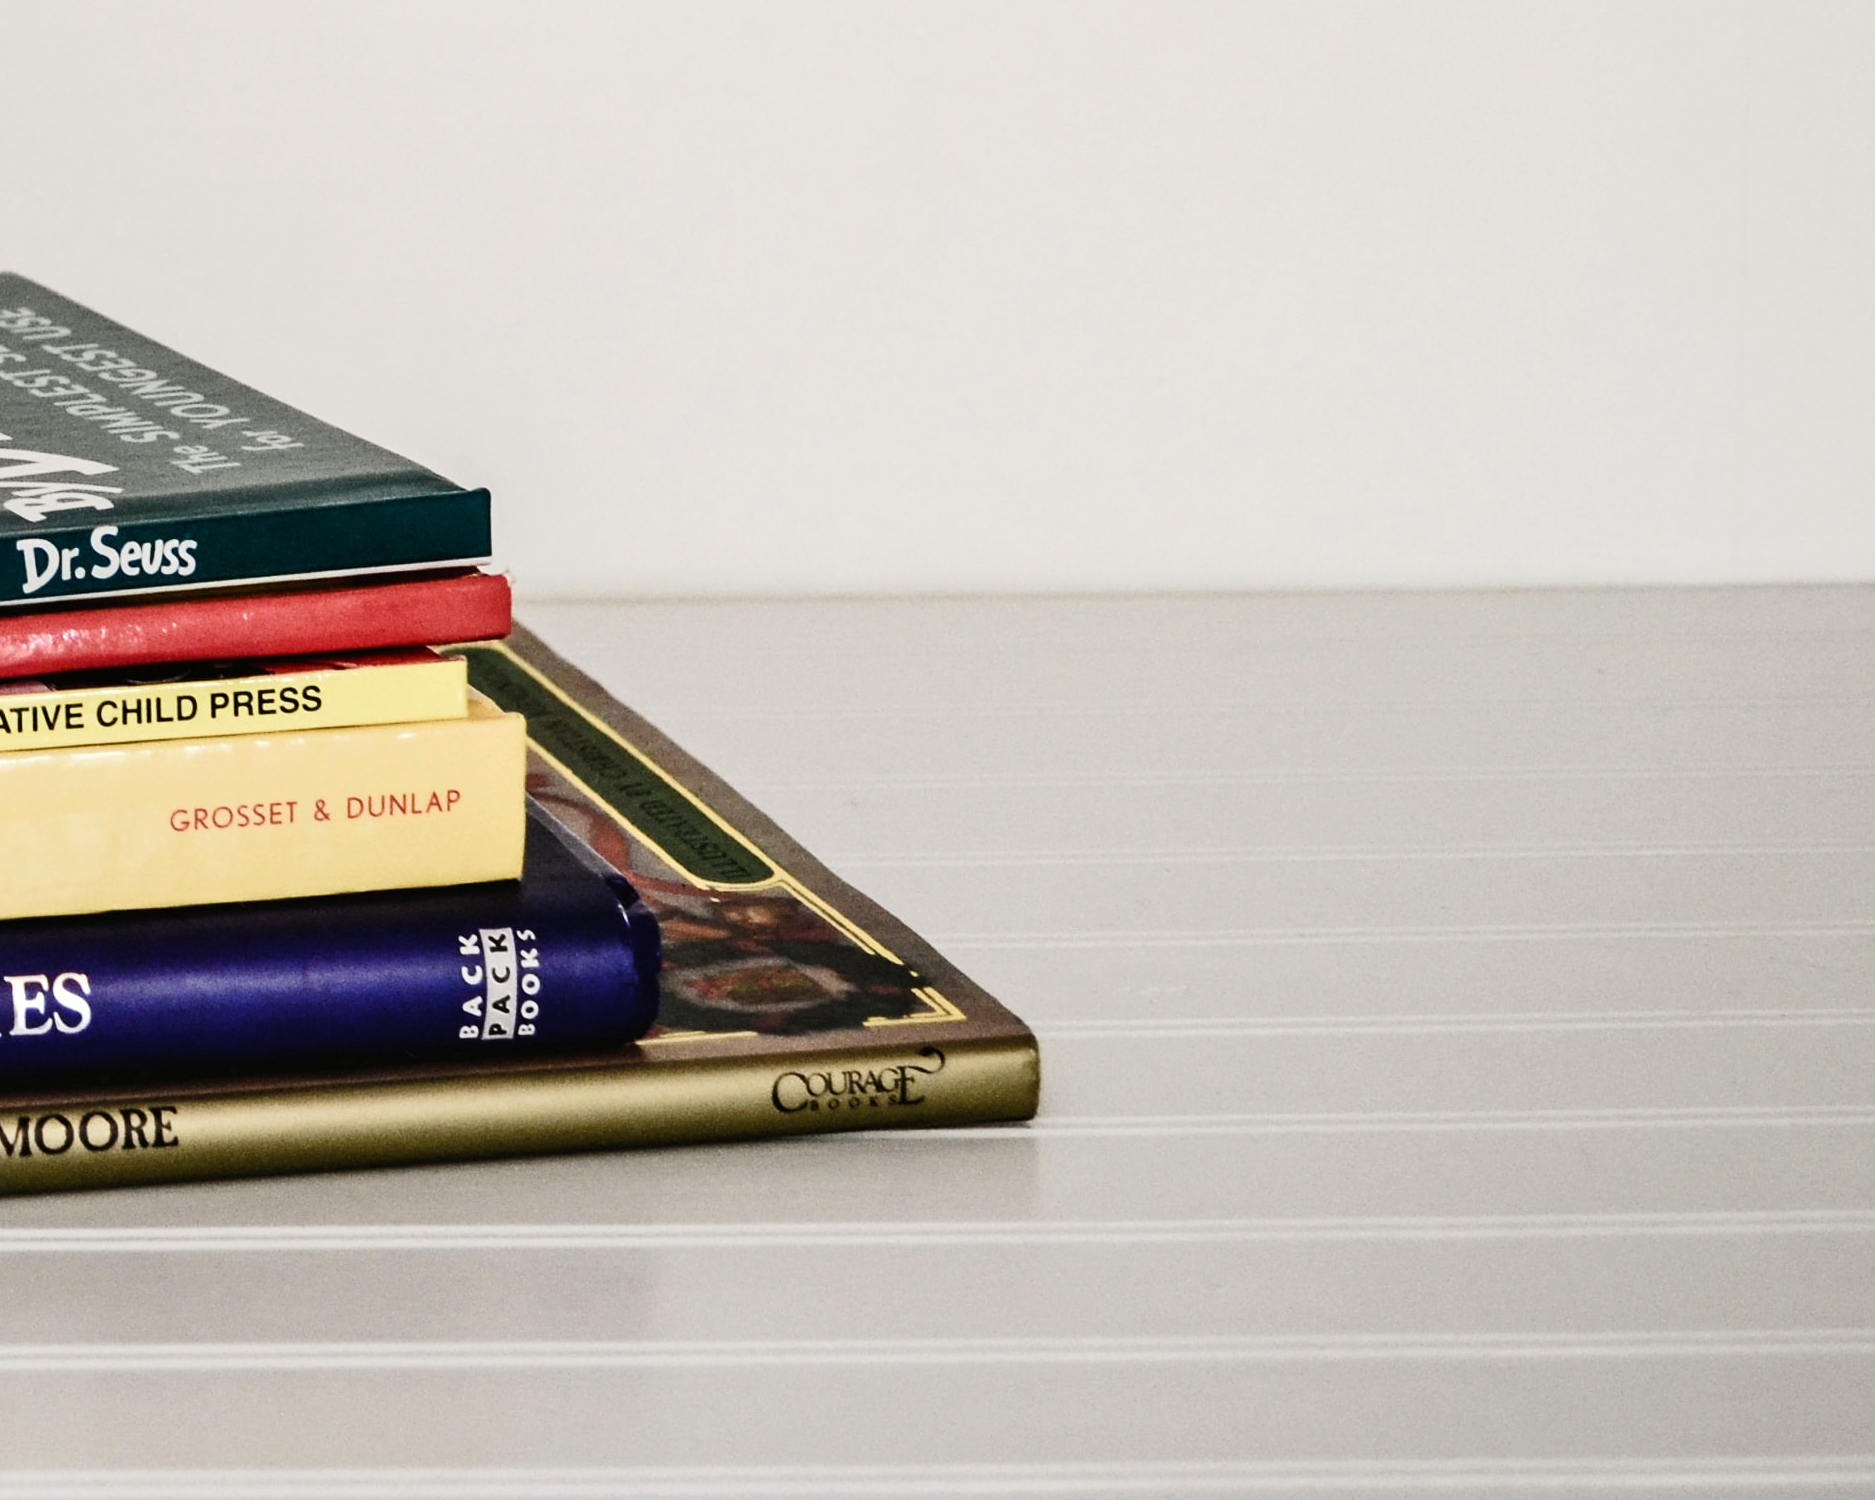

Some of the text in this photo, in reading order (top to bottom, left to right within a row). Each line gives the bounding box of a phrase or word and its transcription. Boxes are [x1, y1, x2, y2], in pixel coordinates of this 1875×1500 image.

[42, 343, 251, 434] YOUNGEST
[171, 445, 241, 475] The
[242, 428, 305, 453] for
[90, 526, 198, 580] Seuss
[96, 693, 198, 725] CHILD
[210, 685, 322, 719] PRESS
[170, 789, 462, 833] GROSSET & DUNLAP
[458, 934, 483, 1039] BACK
[488, 934, 510, 1036] PACK
[516, 929, 540, 1035] BOOKS
[771, 1046, 945, 1113] COURAGE
[809, 1094, 897, 1111] BOOKS
